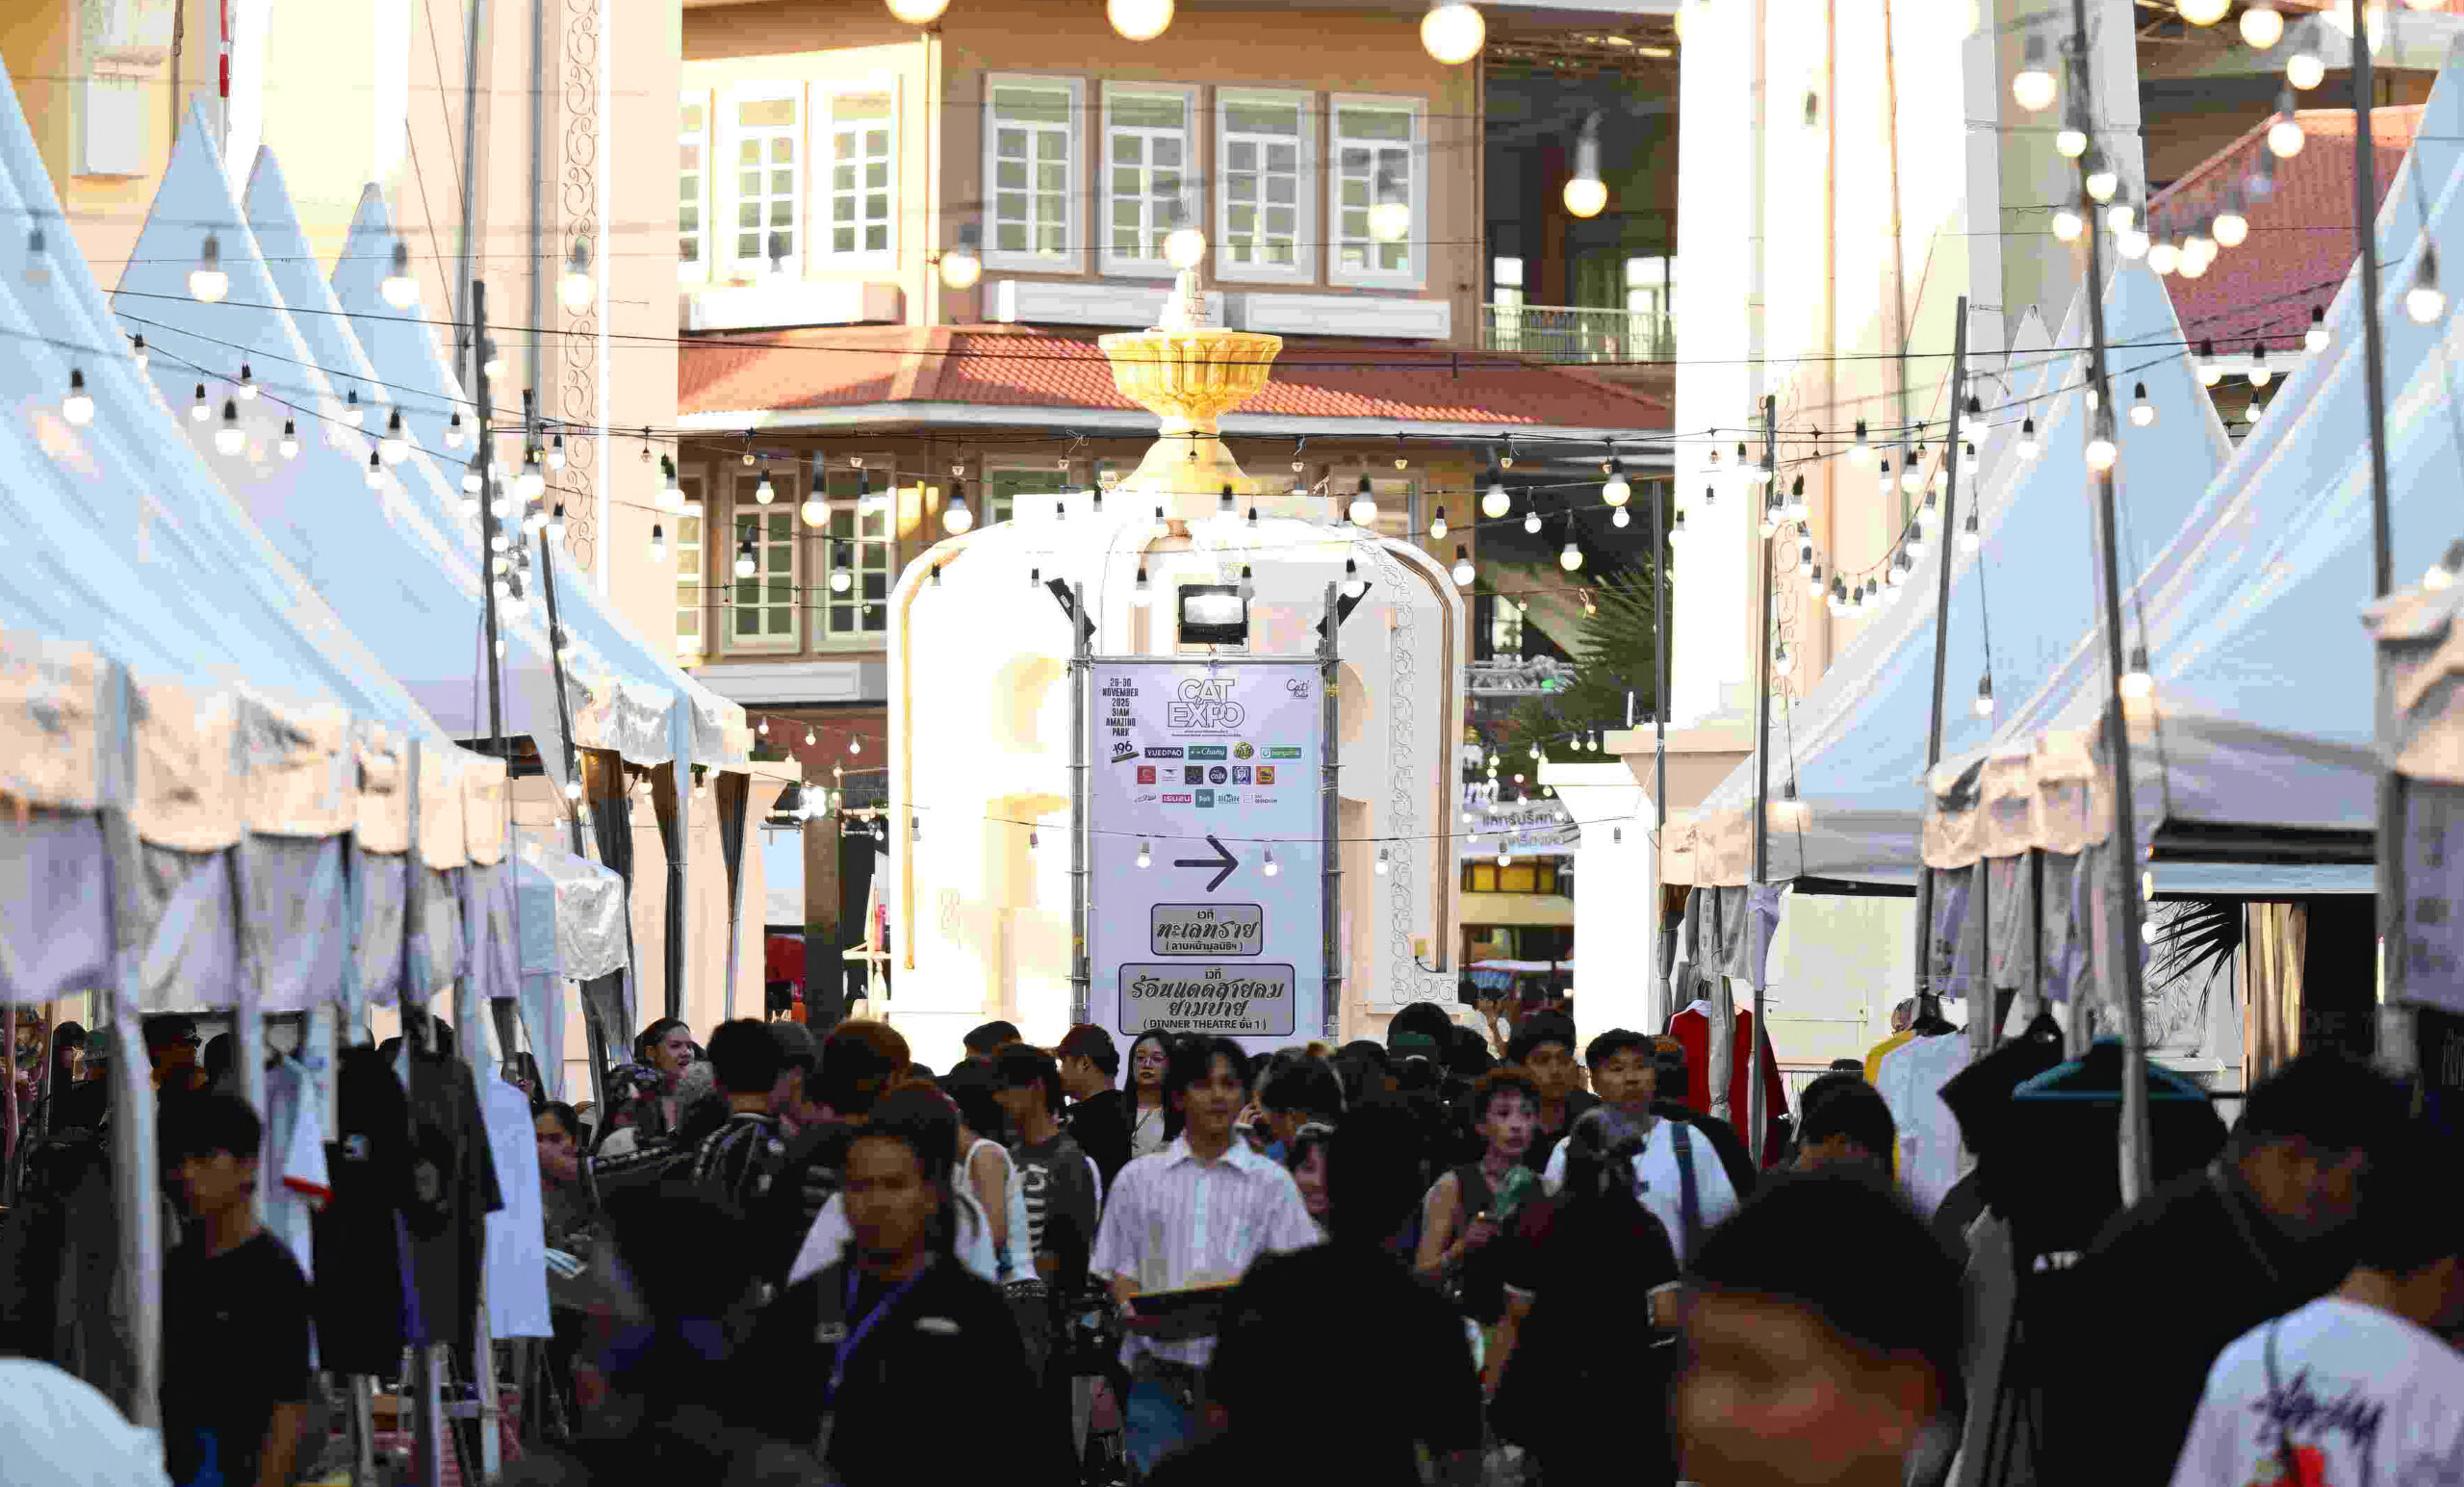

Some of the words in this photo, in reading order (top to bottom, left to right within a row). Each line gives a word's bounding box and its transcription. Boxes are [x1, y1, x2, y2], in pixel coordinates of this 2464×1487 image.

[1102, 687, 1139, 697] NOVEMBER
[1177, 678, 1236, 705] CAT
[1111, 698, 1131, 707] 2025
[1112, 707, 1130, 717] SIAM
[1168, 701, 1245, 729] EXPO
[1105, 717, 1137, 727] AMAZING
[1112, 727, 1131, 736] PARK
[1156, 920, 1260, 939] ทะเลทราย
[1205, 967, 1222, 980] เวที
[1193, 1018, 1237, 1030] THEATRE
